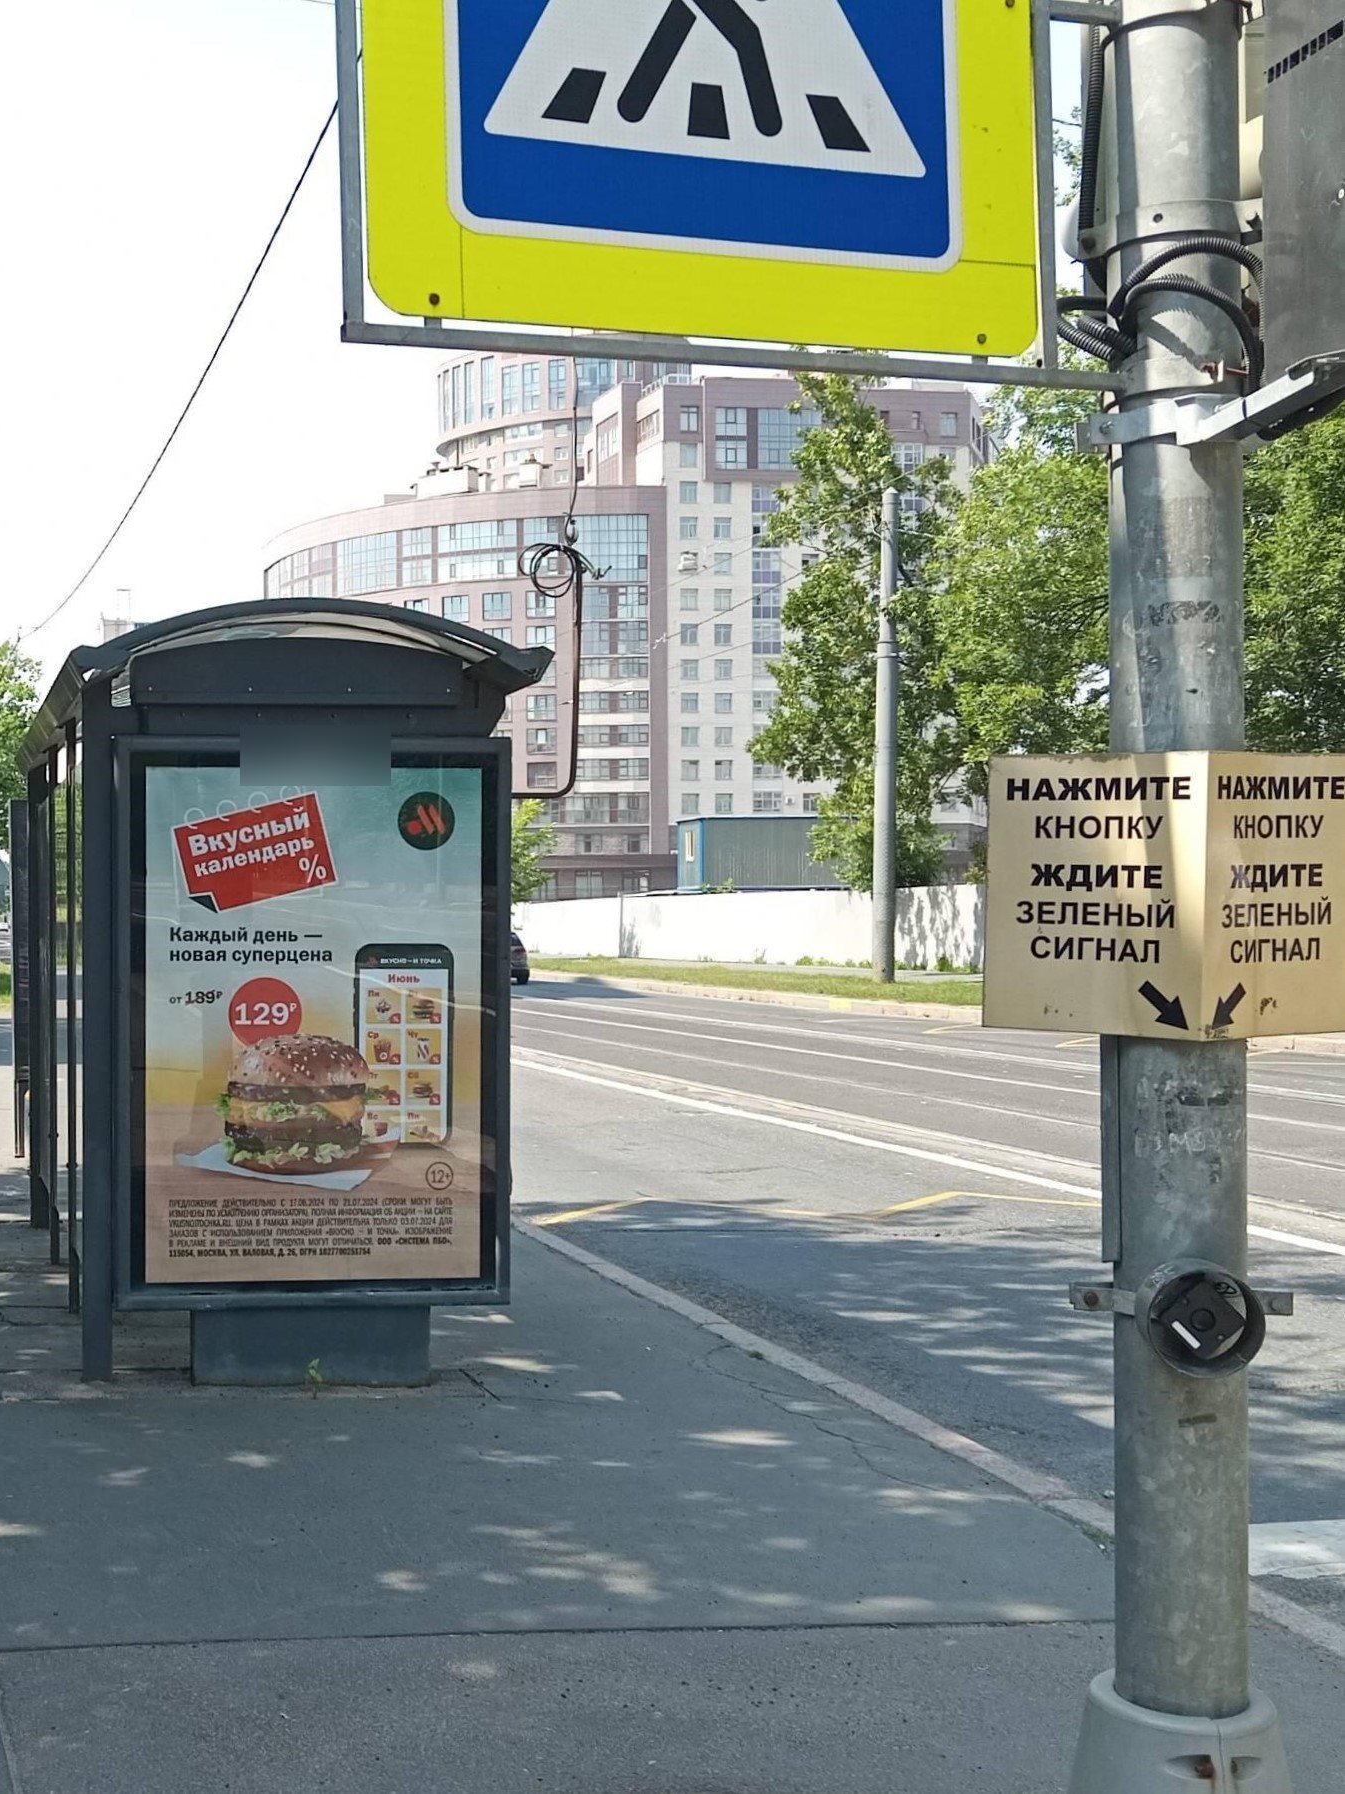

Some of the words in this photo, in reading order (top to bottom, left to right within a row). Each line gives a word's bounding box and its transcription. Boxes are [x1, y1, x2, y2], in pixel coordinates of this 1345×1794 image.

[1006, 776, 1191, 800] НАЖМИТЕ
[1217, 775, 1345, 800] НАЖМИТЕ
[188, 806, 310, 858] Вкусный
[1034, 816, 1164, 840] КНОПКУ
[1234, 814, 1324, 839] КНОПКУ
[194, 836, 315, 878] календарь
[299, 854, 327, 883] %
[1031, 864, 1162, 892] ЖДИТЕ
[1230, 864, 1324, 892] ЖДИТЕ
[1016, 899, 1174, 928] ЗЕЛЕНЫЙ
[1222, 897, 1332, 928] ЗЕЛЕНЫЙ
[169, 926, 248, 946] Каждый
[253, 931, 298, 946] день
[169, 949, 226, 962] новая
[232, 949, 333, 966] суперцена
[1030, 936, 1160, 964] СИГНАЛ
[1230, 937, 1320, 964] СИГНАЛ
[388, 974, 420, 984] Июнь
[169, 995, 182, 1004] от
[367, 1031, 379, 1039] Ср
[431, 1170, 451, 1184] 12+
